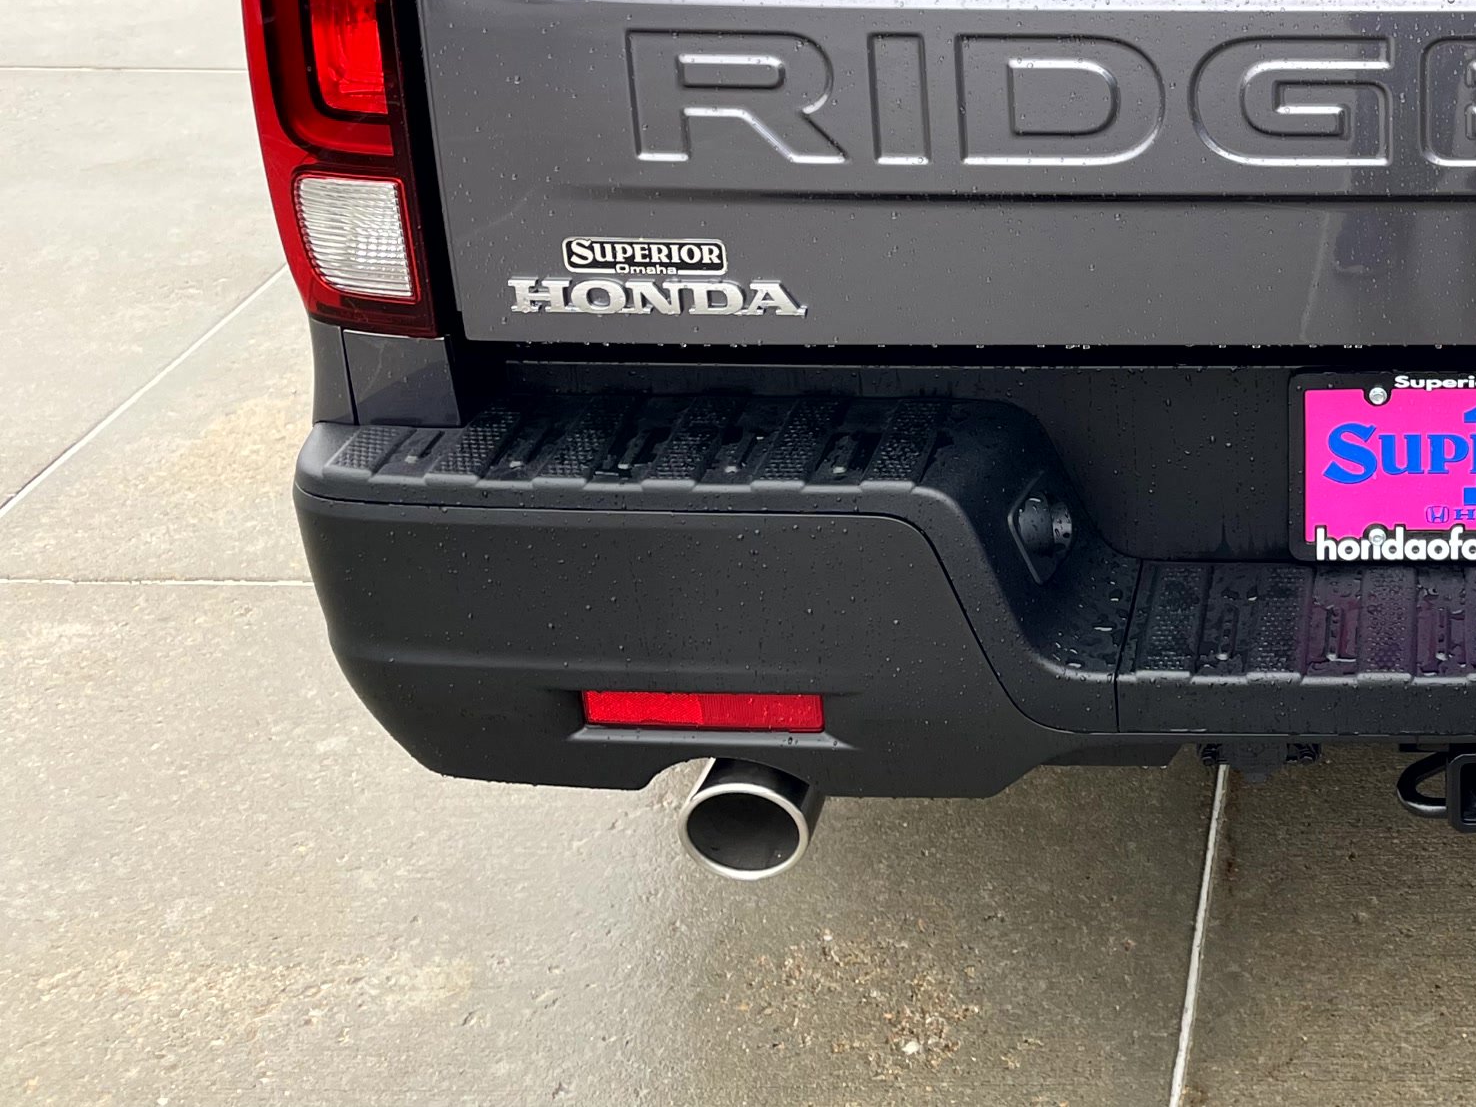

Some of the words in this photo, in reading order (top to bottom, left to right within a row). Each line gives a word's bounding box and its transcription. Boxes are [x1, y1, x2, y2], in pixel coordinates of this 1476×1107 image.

[570, 239, 721, 265] SUPERIOR
[615, 264, 677, 275] Omaha
[508, 277, 807, 317] HONDA
